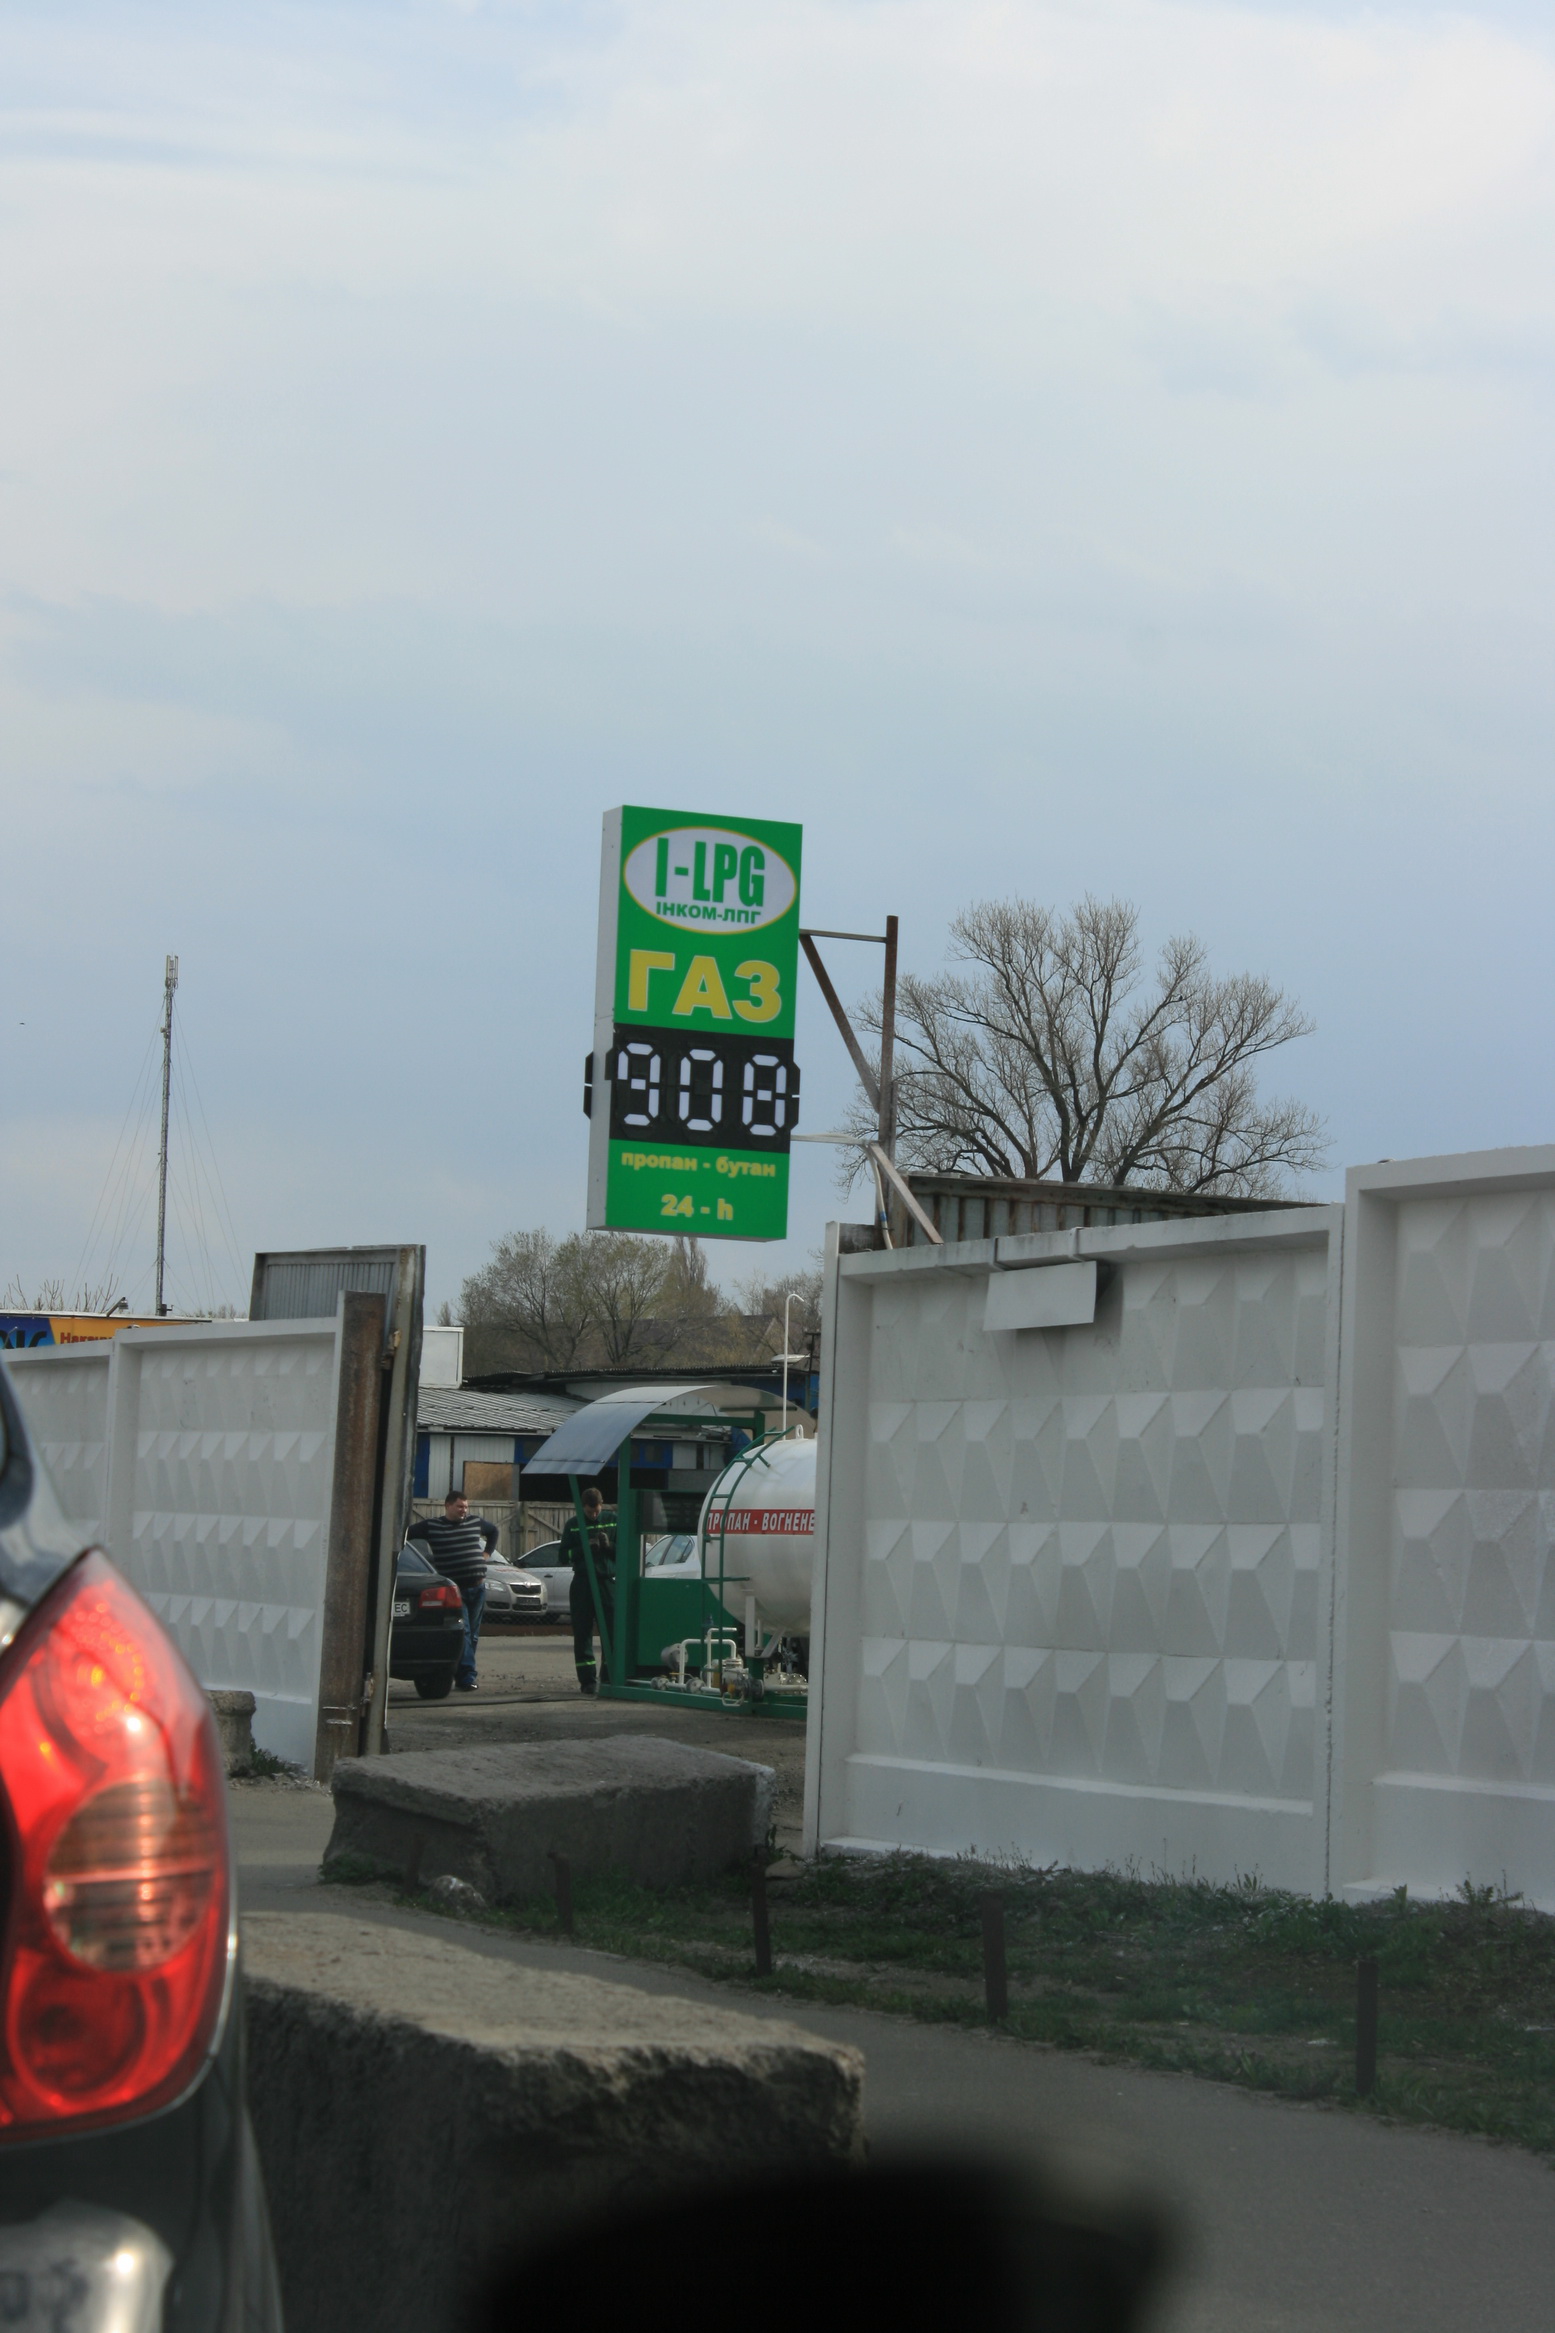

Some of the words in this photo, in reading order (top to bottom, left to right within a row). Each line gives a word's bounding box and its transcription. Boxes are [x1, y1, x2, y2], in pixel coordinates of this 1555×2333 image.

[655, 837, 765, 907] I-LPG
[656, 901, 761, 924] ІНКОМ-ЛПГ
[628, 949, 782, 1023] ГАЗ
[621, 1152, 698, 1171] пропан
[716, 1156, 776, 1178] бутан
[660, 1194, 694, 1218] 24
[717, 1198, 734, 1221] h
